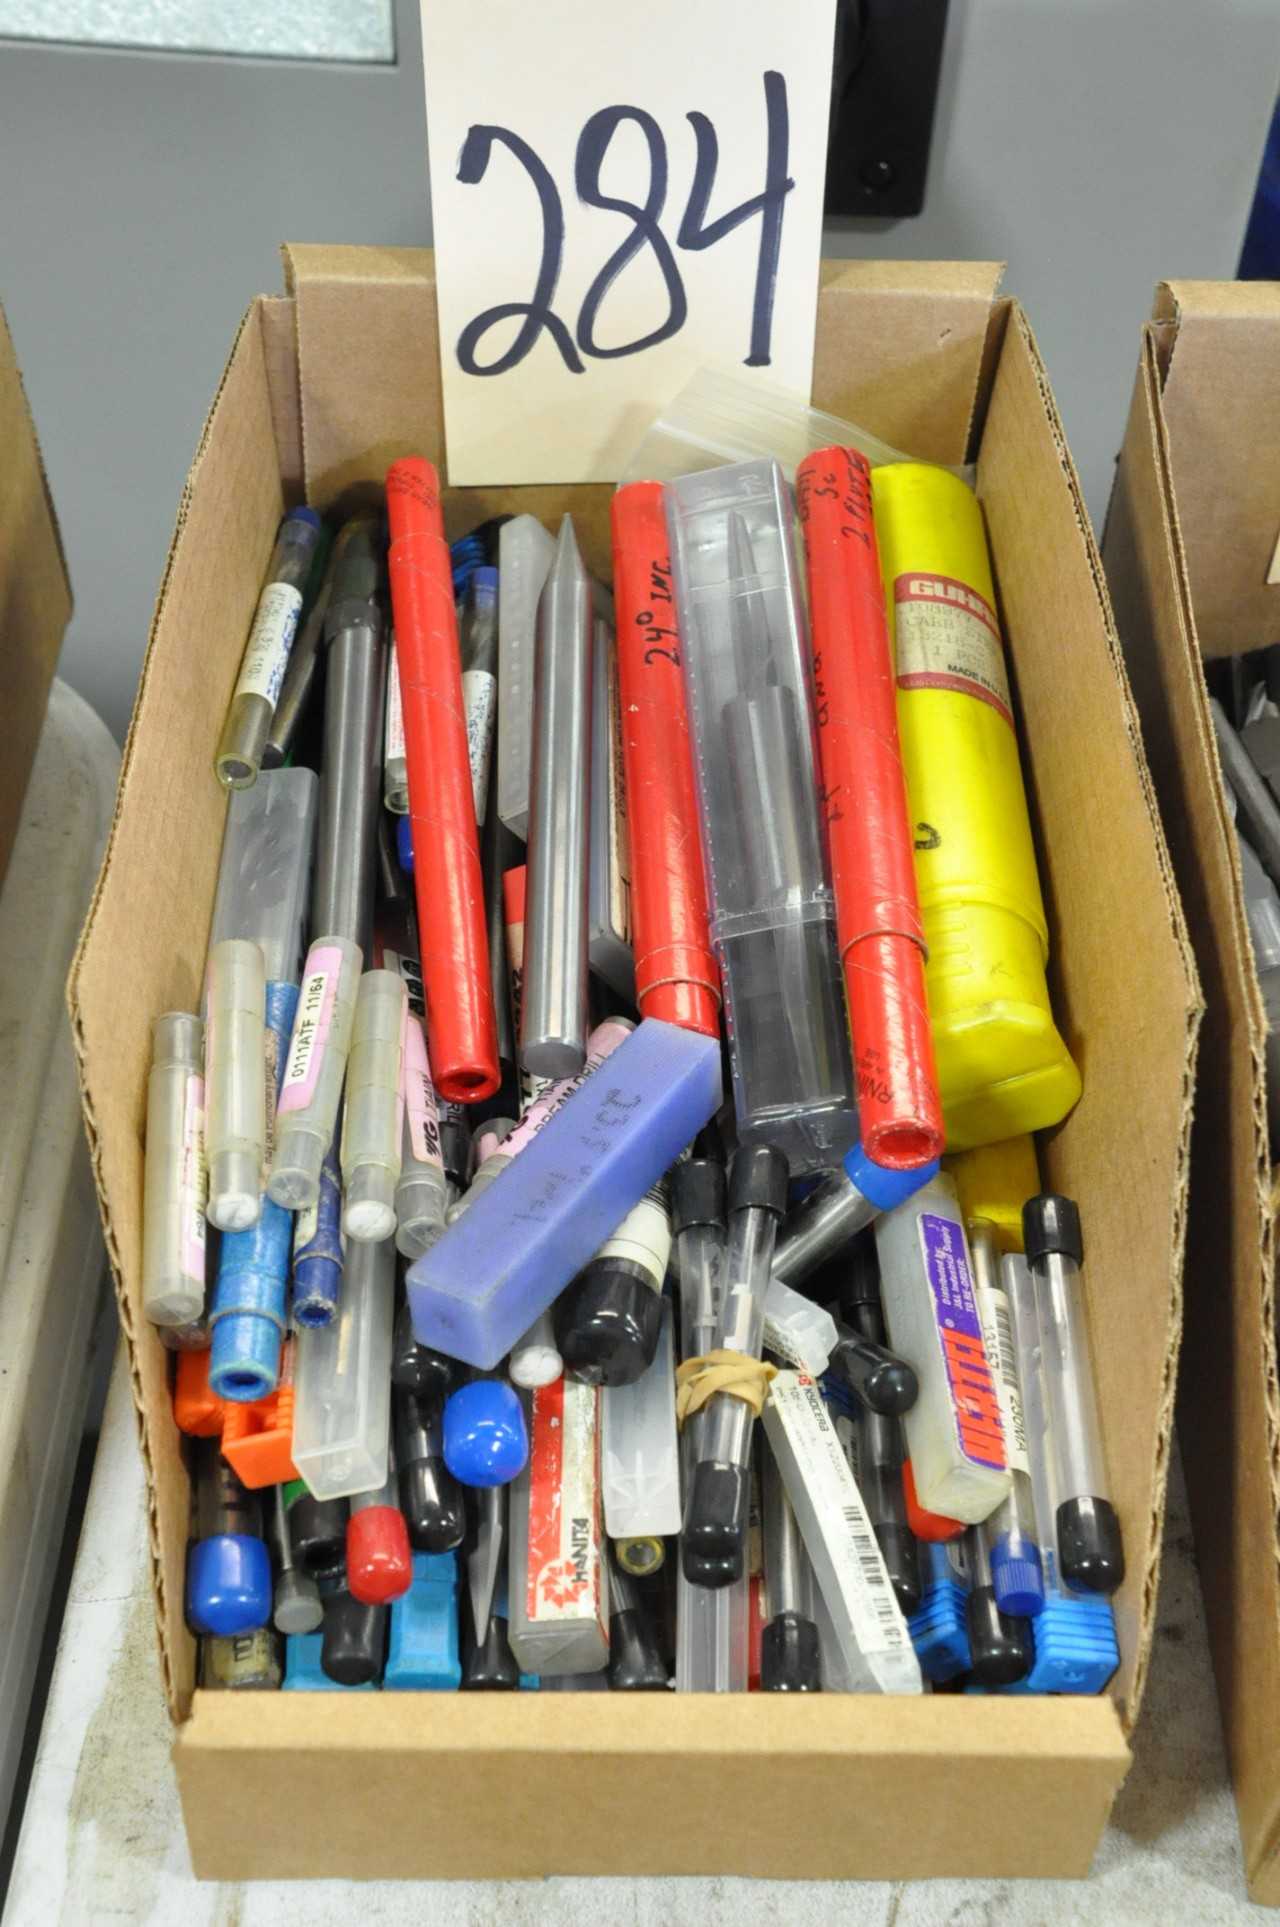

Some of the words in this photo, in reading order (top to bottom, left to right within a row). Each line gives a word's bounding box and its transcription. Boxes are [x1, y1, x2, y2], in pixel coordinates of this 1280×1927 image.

[455, 70, 795, 377] 284
[947, 663, 979, 680] MADE
[306, 976, 324, 1010] 11/64
[804, 1388, 830, 1432] KYOCERA
[571, 1518, 589, 1583] HANITA
